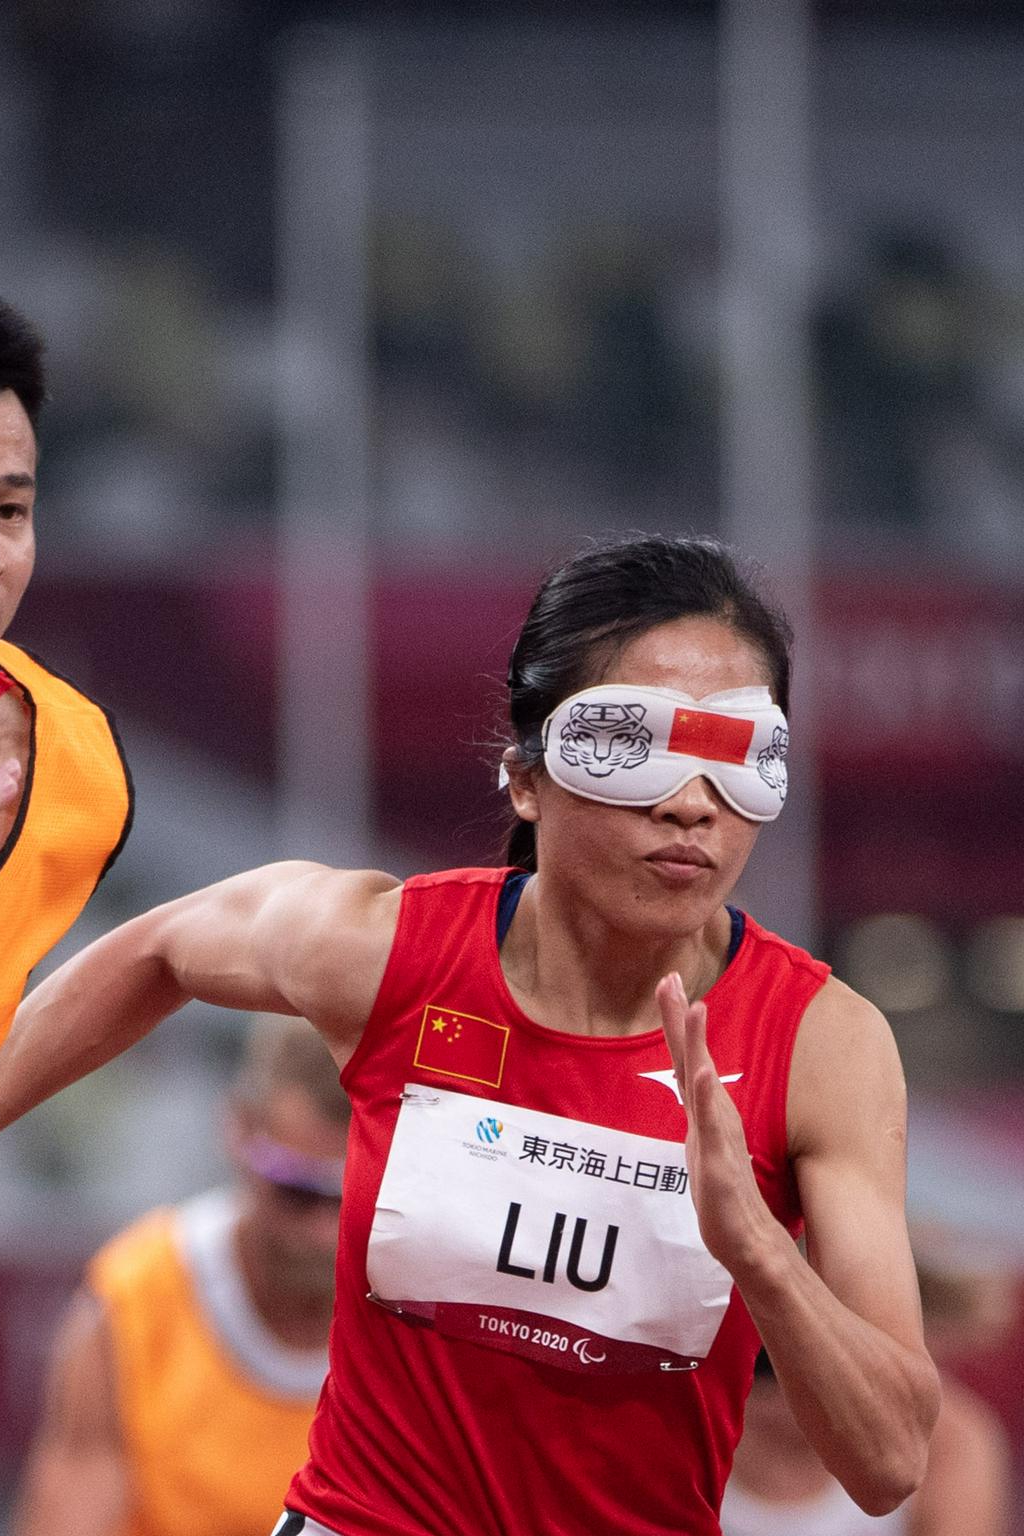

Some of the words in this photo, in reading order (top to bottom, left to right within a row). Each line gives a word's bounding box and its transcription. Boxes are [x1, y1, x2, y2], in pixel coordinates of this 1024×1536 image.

[518, 1135, 688, 1195] 東京海上日動
[496, 1202, 620, 1293] LIU
[479, 1314, 529, 1340] TOKYO
[532, 1328, 569, 1352] 2020
